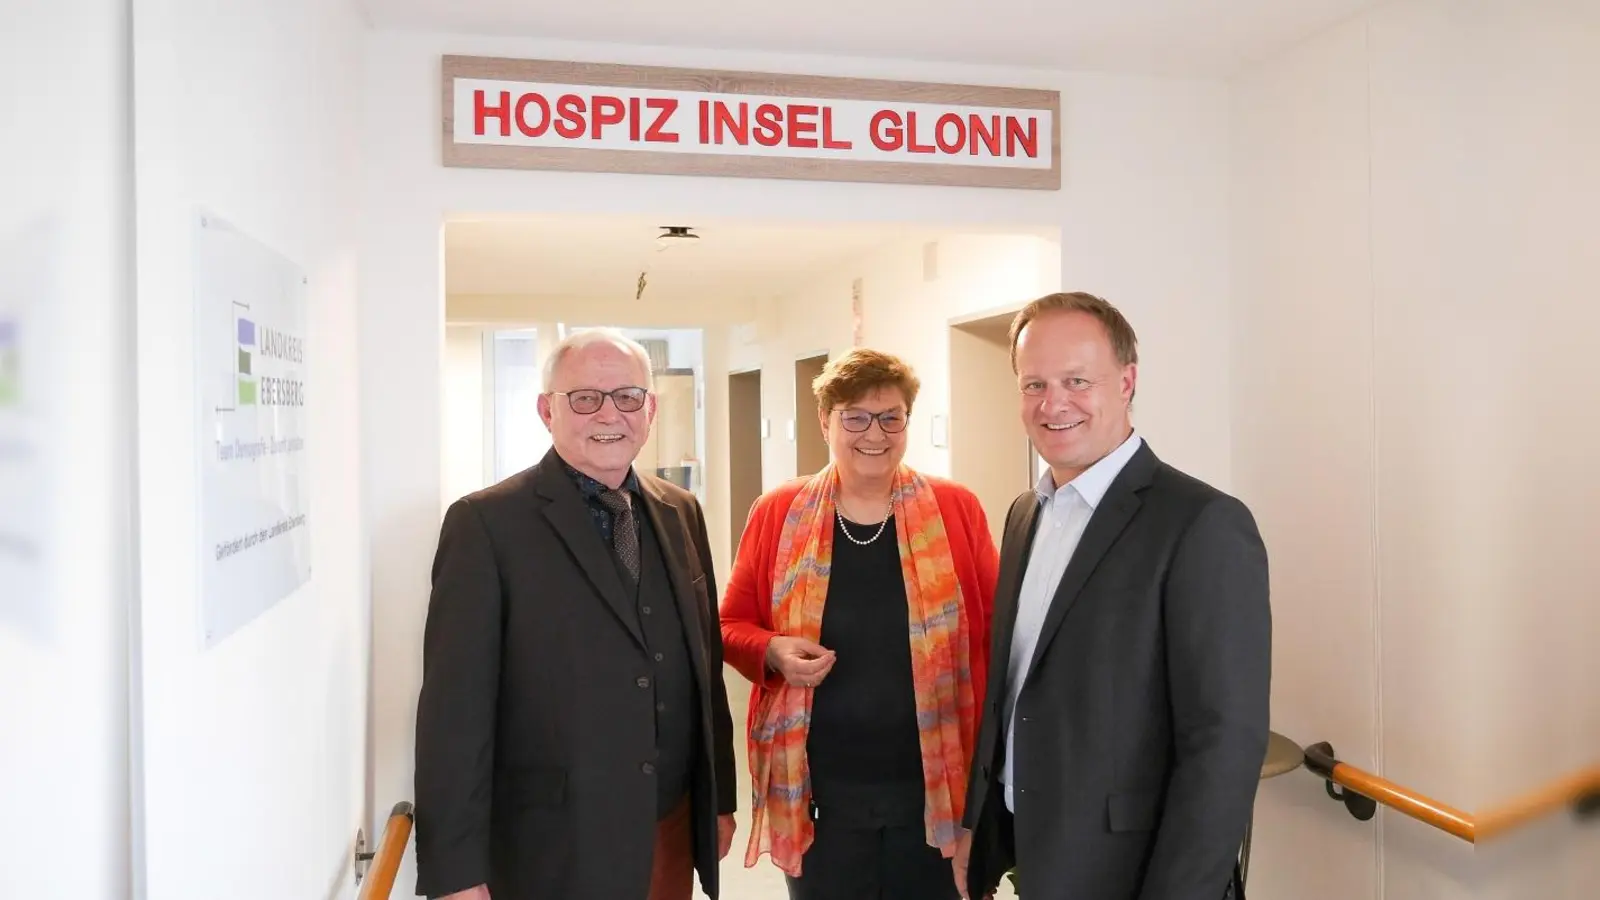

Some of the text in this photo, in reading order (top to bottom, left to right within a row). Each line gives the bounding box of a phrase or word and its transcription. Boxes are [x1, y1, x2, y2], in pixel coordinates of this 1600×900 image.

[473, 90, 1038, 158] HOSPIZ INSEL GLONN
[260, 325, 303, 363] LANDKREIS
[261, 376, 304, 407] EBERSBERG
